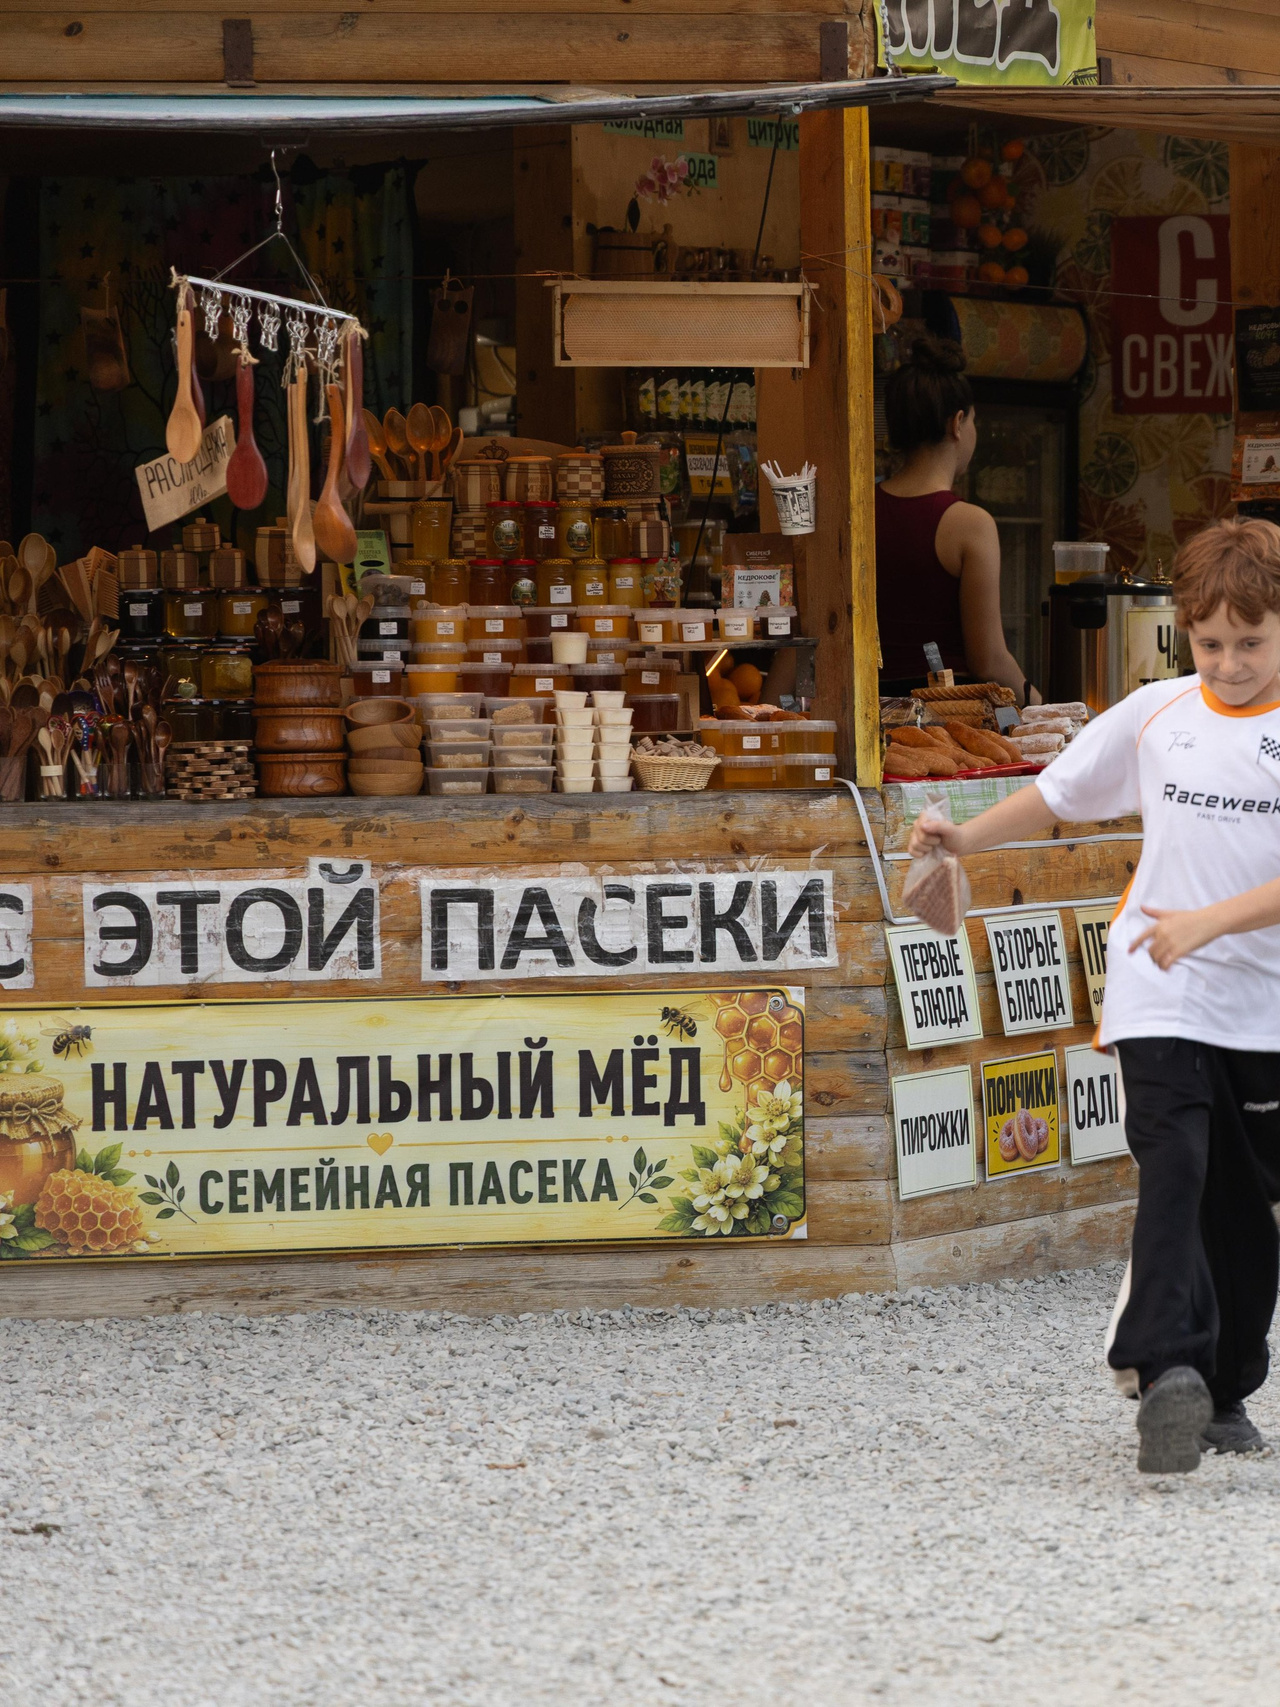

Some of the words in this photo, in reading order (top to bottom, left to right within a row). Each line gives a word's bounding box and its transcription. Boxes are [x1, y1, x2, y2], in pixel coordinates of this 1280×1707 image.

[688, 157, 716, 185] ода
[1197, 812, 1216, 823] FAST
[1217, 814, 1242, 825] DRIVE
[92, 863, 375, 976] ЭТОЙ
[430, 878, 829, 971] ПАСЕКИ
[900, 938, 964, 983] ПЕРВЫЕ
[993, 924, 1061, 973] ВТОРЫЕ
[910, 984, 969, 1029] БЛЮДА
[1004, 974, 1066, 1024] БЛЮДА
[91, 1036, 554, 1132] НАТУРАЛЬНЫЙ
[578, 1034, 706, 1127] МЁД
[985, 1066, 1057, 1118] ПОНЧИКИ
[1073, 1072, 1119, 1131] САЛ
[900, 1107, 970, 1157] ПИРОЖКИ
[199, 1157, 431, 1215] СЕМЕЙНАЯ
[449, 1158, 619, 1206] ПАСЕКА
